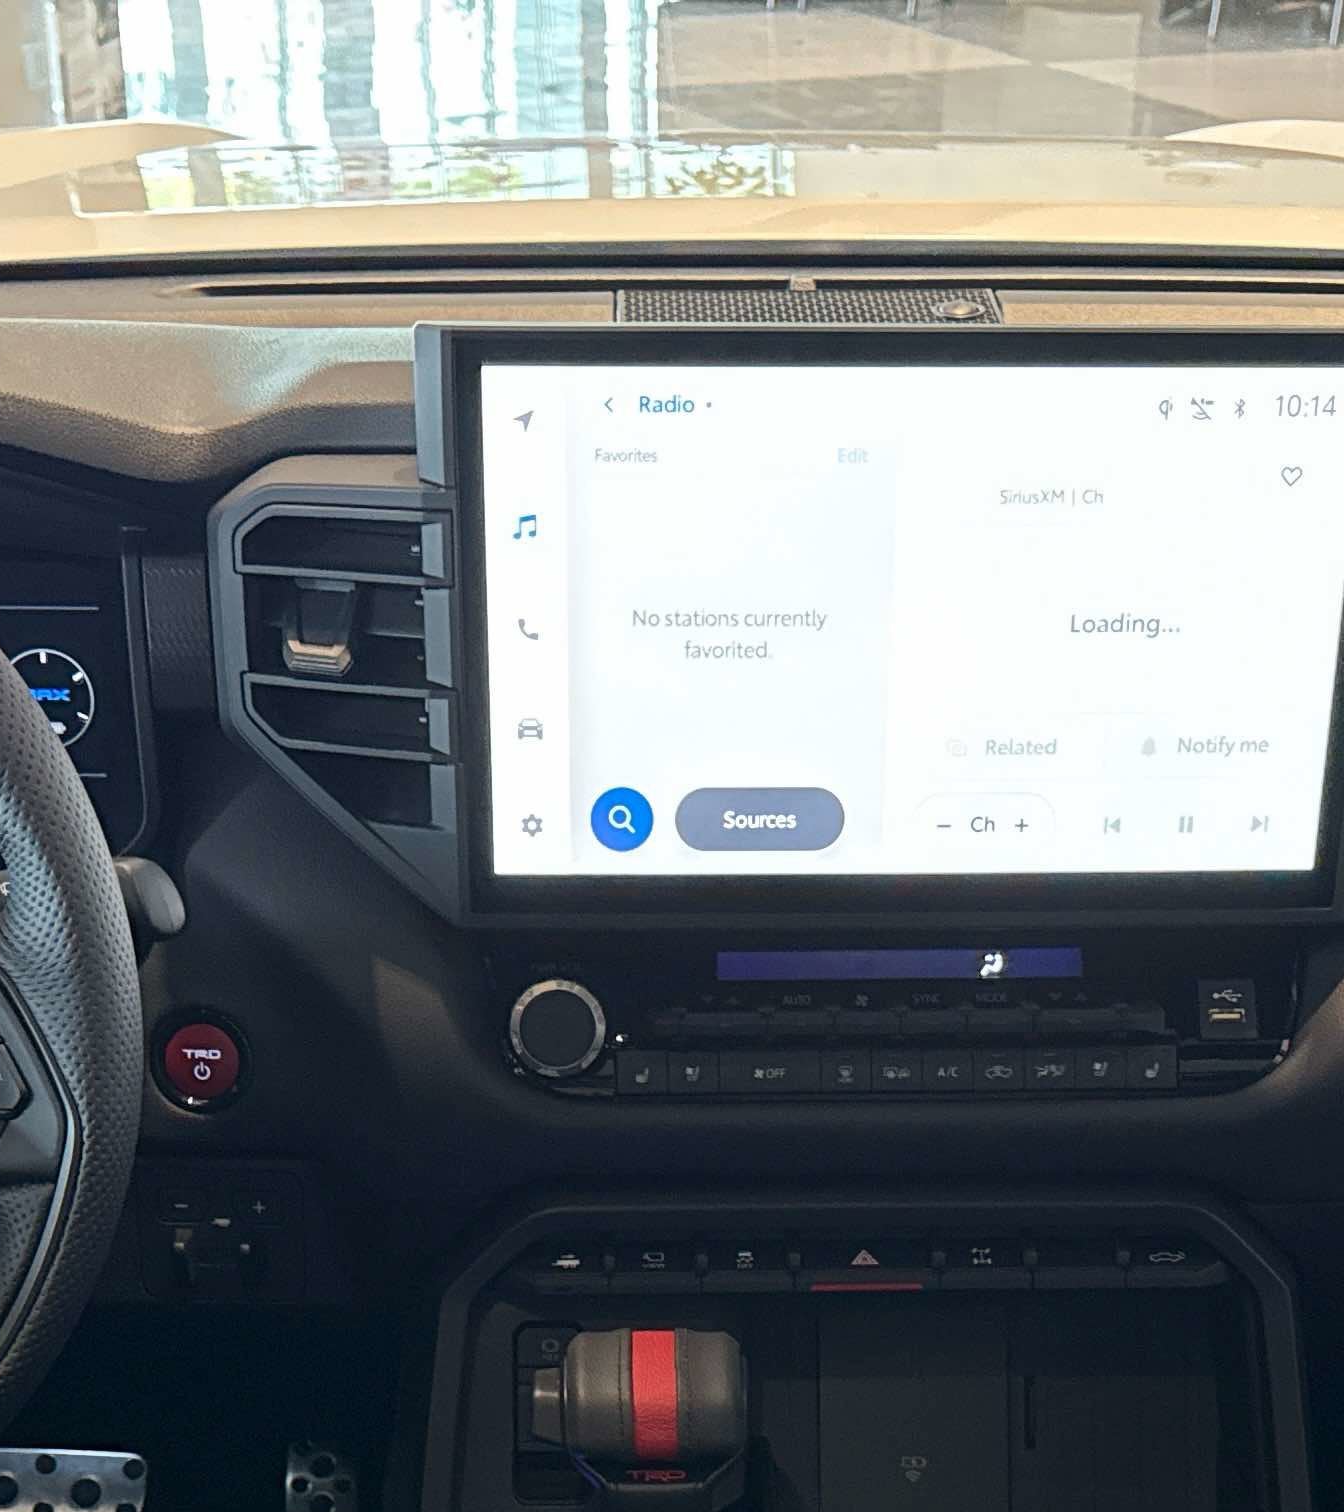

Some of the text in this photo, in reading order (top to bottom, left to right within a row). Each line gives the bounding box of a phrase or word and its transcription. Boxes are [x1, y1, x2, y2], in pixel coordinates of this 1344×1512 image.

[639, 395, 695, 413] Radio
[1275, 394, 1337, 418] 10:14
[594, 448, 658, 463] Favorites
[837, 447, 869, 464] Edit
[999, 489, 1104, 505] SiriusXM Ch
[632, 609, 827, 631] No stations currently
[1070, 612, 1181, 639] Loading...
[684, 640, 773, 659] favorited.
[985, 738, 1057, 756] Related
[1177, 735, 1270, 758] Notify me
[722, 810, 797, 830] Sources
[970, 816, 995, 832] Ch
[181, 1048, 222, 1060] TRD
[765, 1067, 787, 1080] OFF
[937, 1066, 959, 1078] A/C
[625, 1470, 687, 1481] TRD
